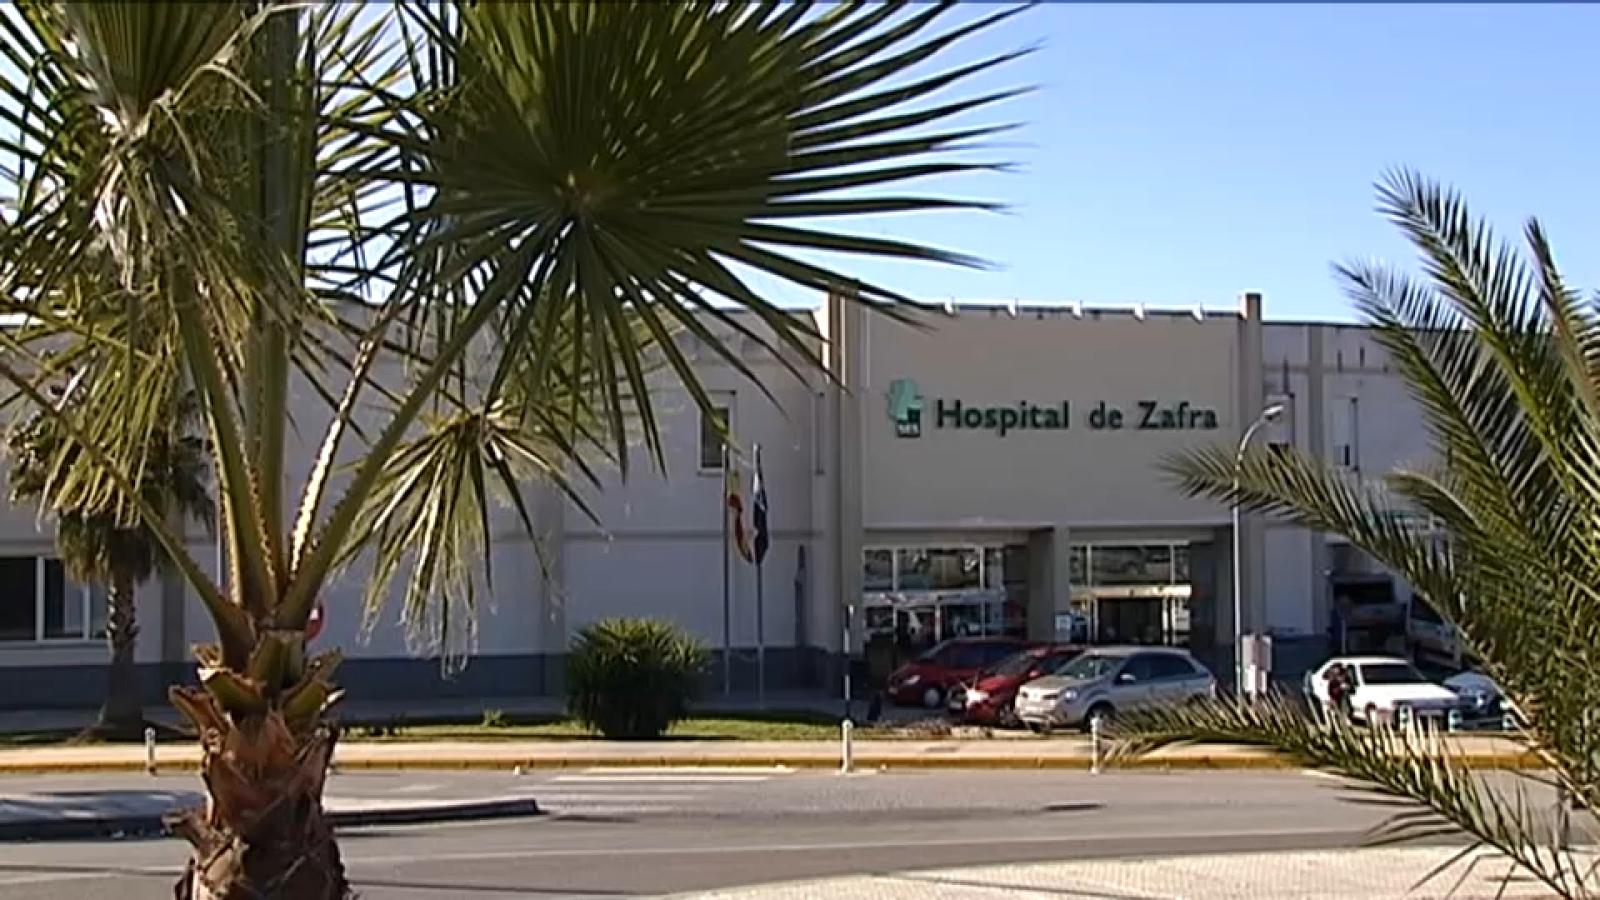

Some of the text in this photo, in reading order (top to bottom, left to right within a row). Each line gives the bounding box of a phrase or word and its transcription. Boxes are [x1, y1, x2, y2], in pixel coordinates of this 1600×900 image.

[936, 399, 1218, 437] Hospital de Zafra
